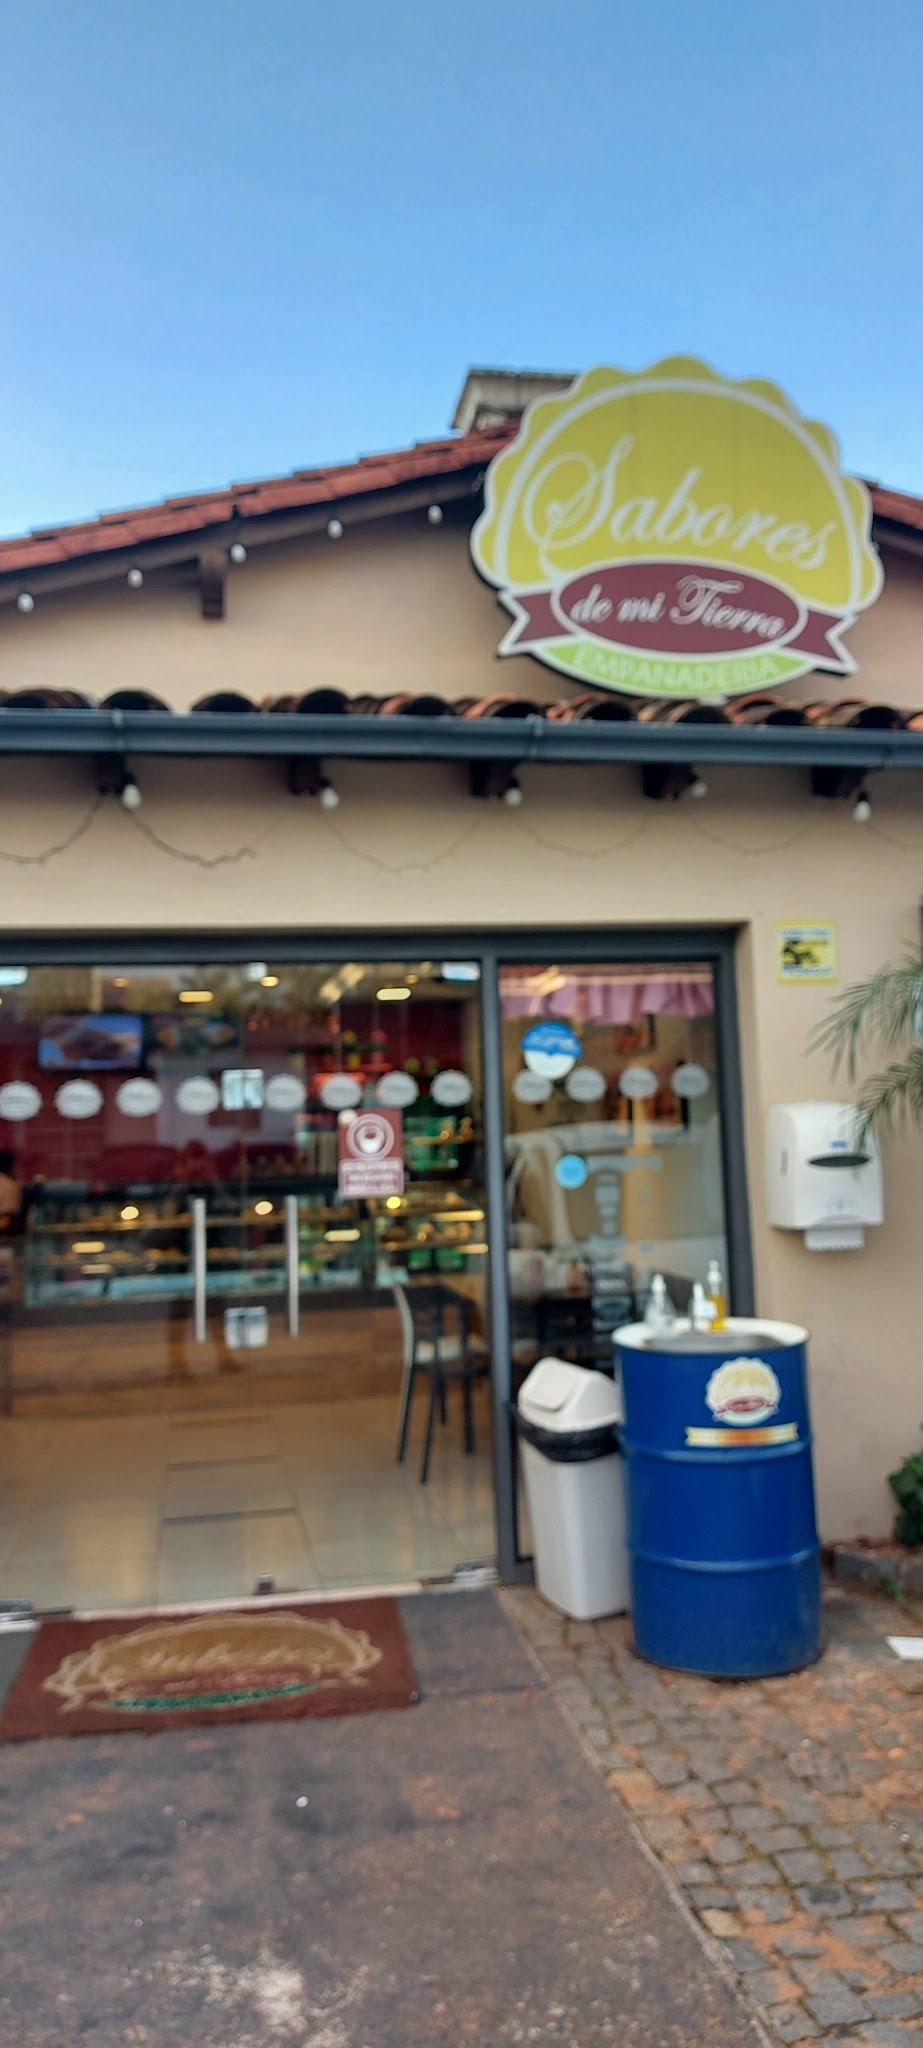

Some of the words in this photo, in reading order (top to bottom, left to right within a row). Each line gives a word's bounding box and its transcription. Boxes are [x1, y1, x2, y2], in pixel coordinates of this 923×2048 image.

[522, 435, 837, 571] Sabores
[569, 583, 614, 623] de
[616, 590, 667, 623] mi
[669, 573, 786, 639] Tierra
